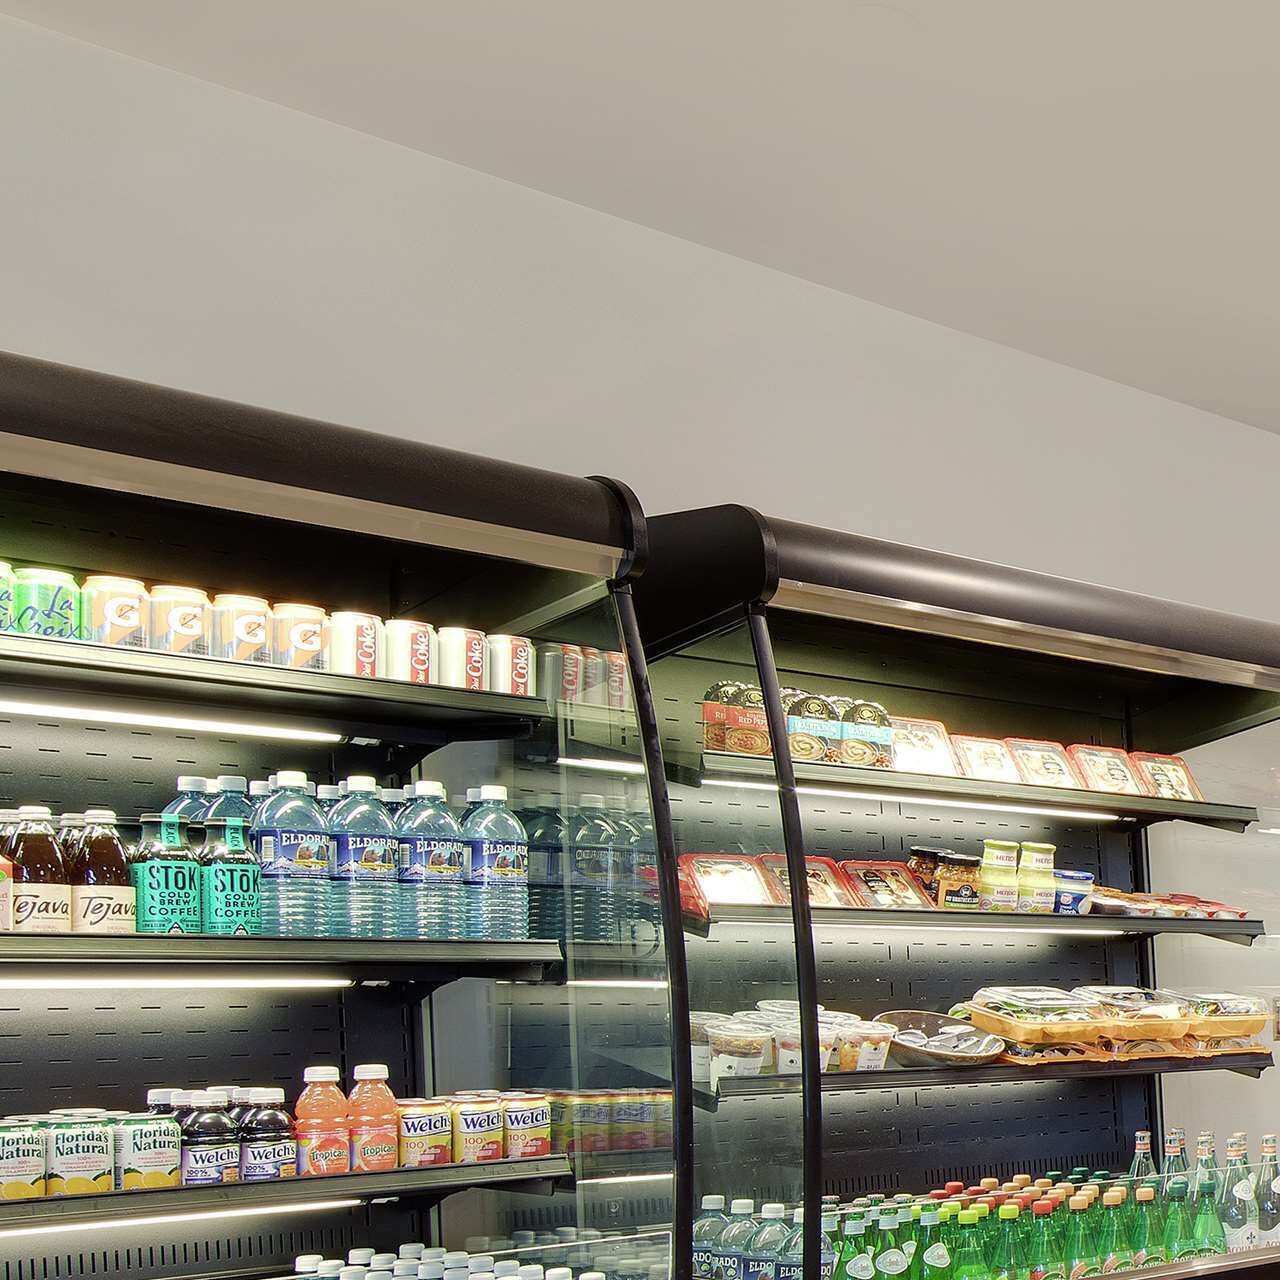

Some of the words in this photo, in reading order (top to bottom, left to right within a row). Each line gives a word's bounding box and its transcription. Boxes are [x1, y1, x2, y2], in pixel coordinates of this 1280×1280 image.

[357, 622, 377, 663] Coke
[412, 633, 430, 672] Coke
[467, 638, 484, 678] Coke
[512, 643, 530, 683] Coke
[159, 891, 191, 899] COLD
[159, 899, 192, 907] BREW
[224, 894, 255, 902] COLD
[148, 906, 198, 917] COFFEE
[214, 908, 261, 919] COFFEE
[55, 1126, 109, 1146] Florida's
[132, 1127, 180, 1143] Florida's
[55, 1141, 109, 1158] Natural
[192, 1147, 239, 1165] Welch's
[250, 1144, 295, 1162] Welch's
